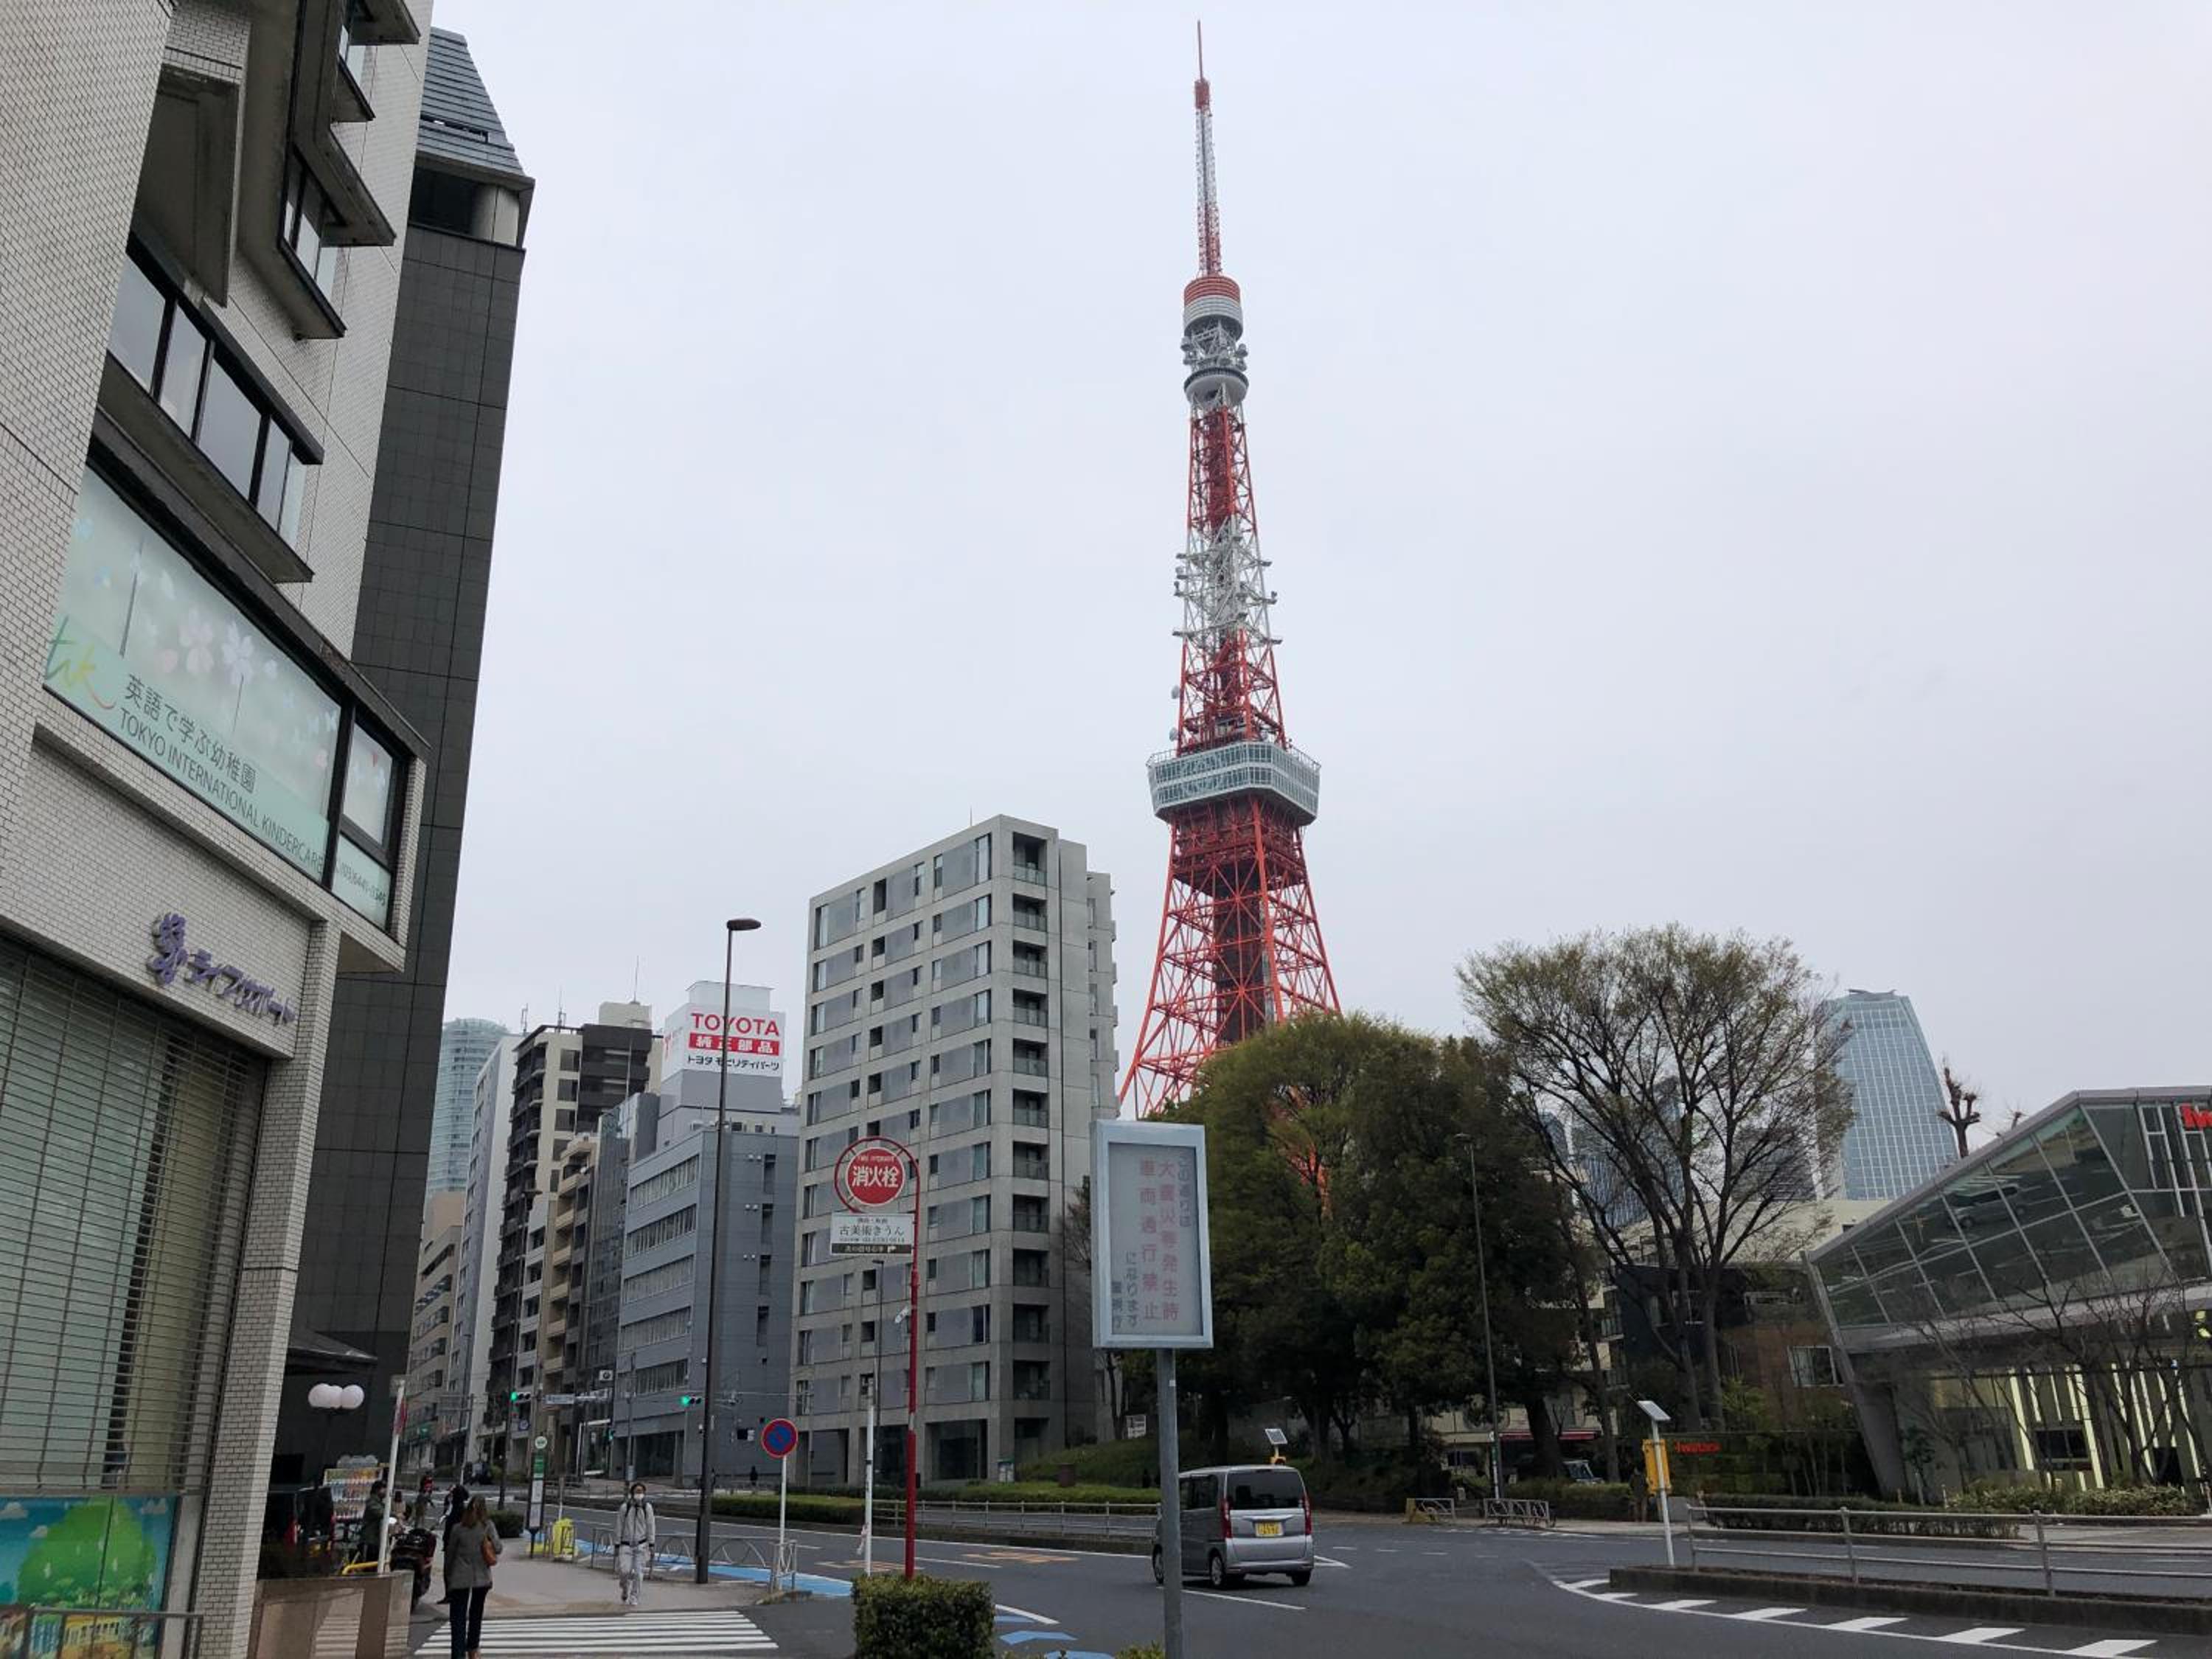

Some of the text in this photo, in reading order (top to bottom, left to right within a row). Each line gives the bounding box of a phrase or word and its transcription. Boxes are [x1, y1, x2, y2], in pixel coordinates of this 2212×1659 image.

[125, 673, 257, 794] 英語で学ぶ幼稚園
[119, 707, 324, 874] TOKYO INTERNATIONAL KINDERCARE
[691, 1013, 779, 1036] TOYOTA
[695, 1036, 773, 1054] 純正部品
[688, 1055, 713, 1066] トヨタ
[852, 1165, 899, 1188] 消火栓
